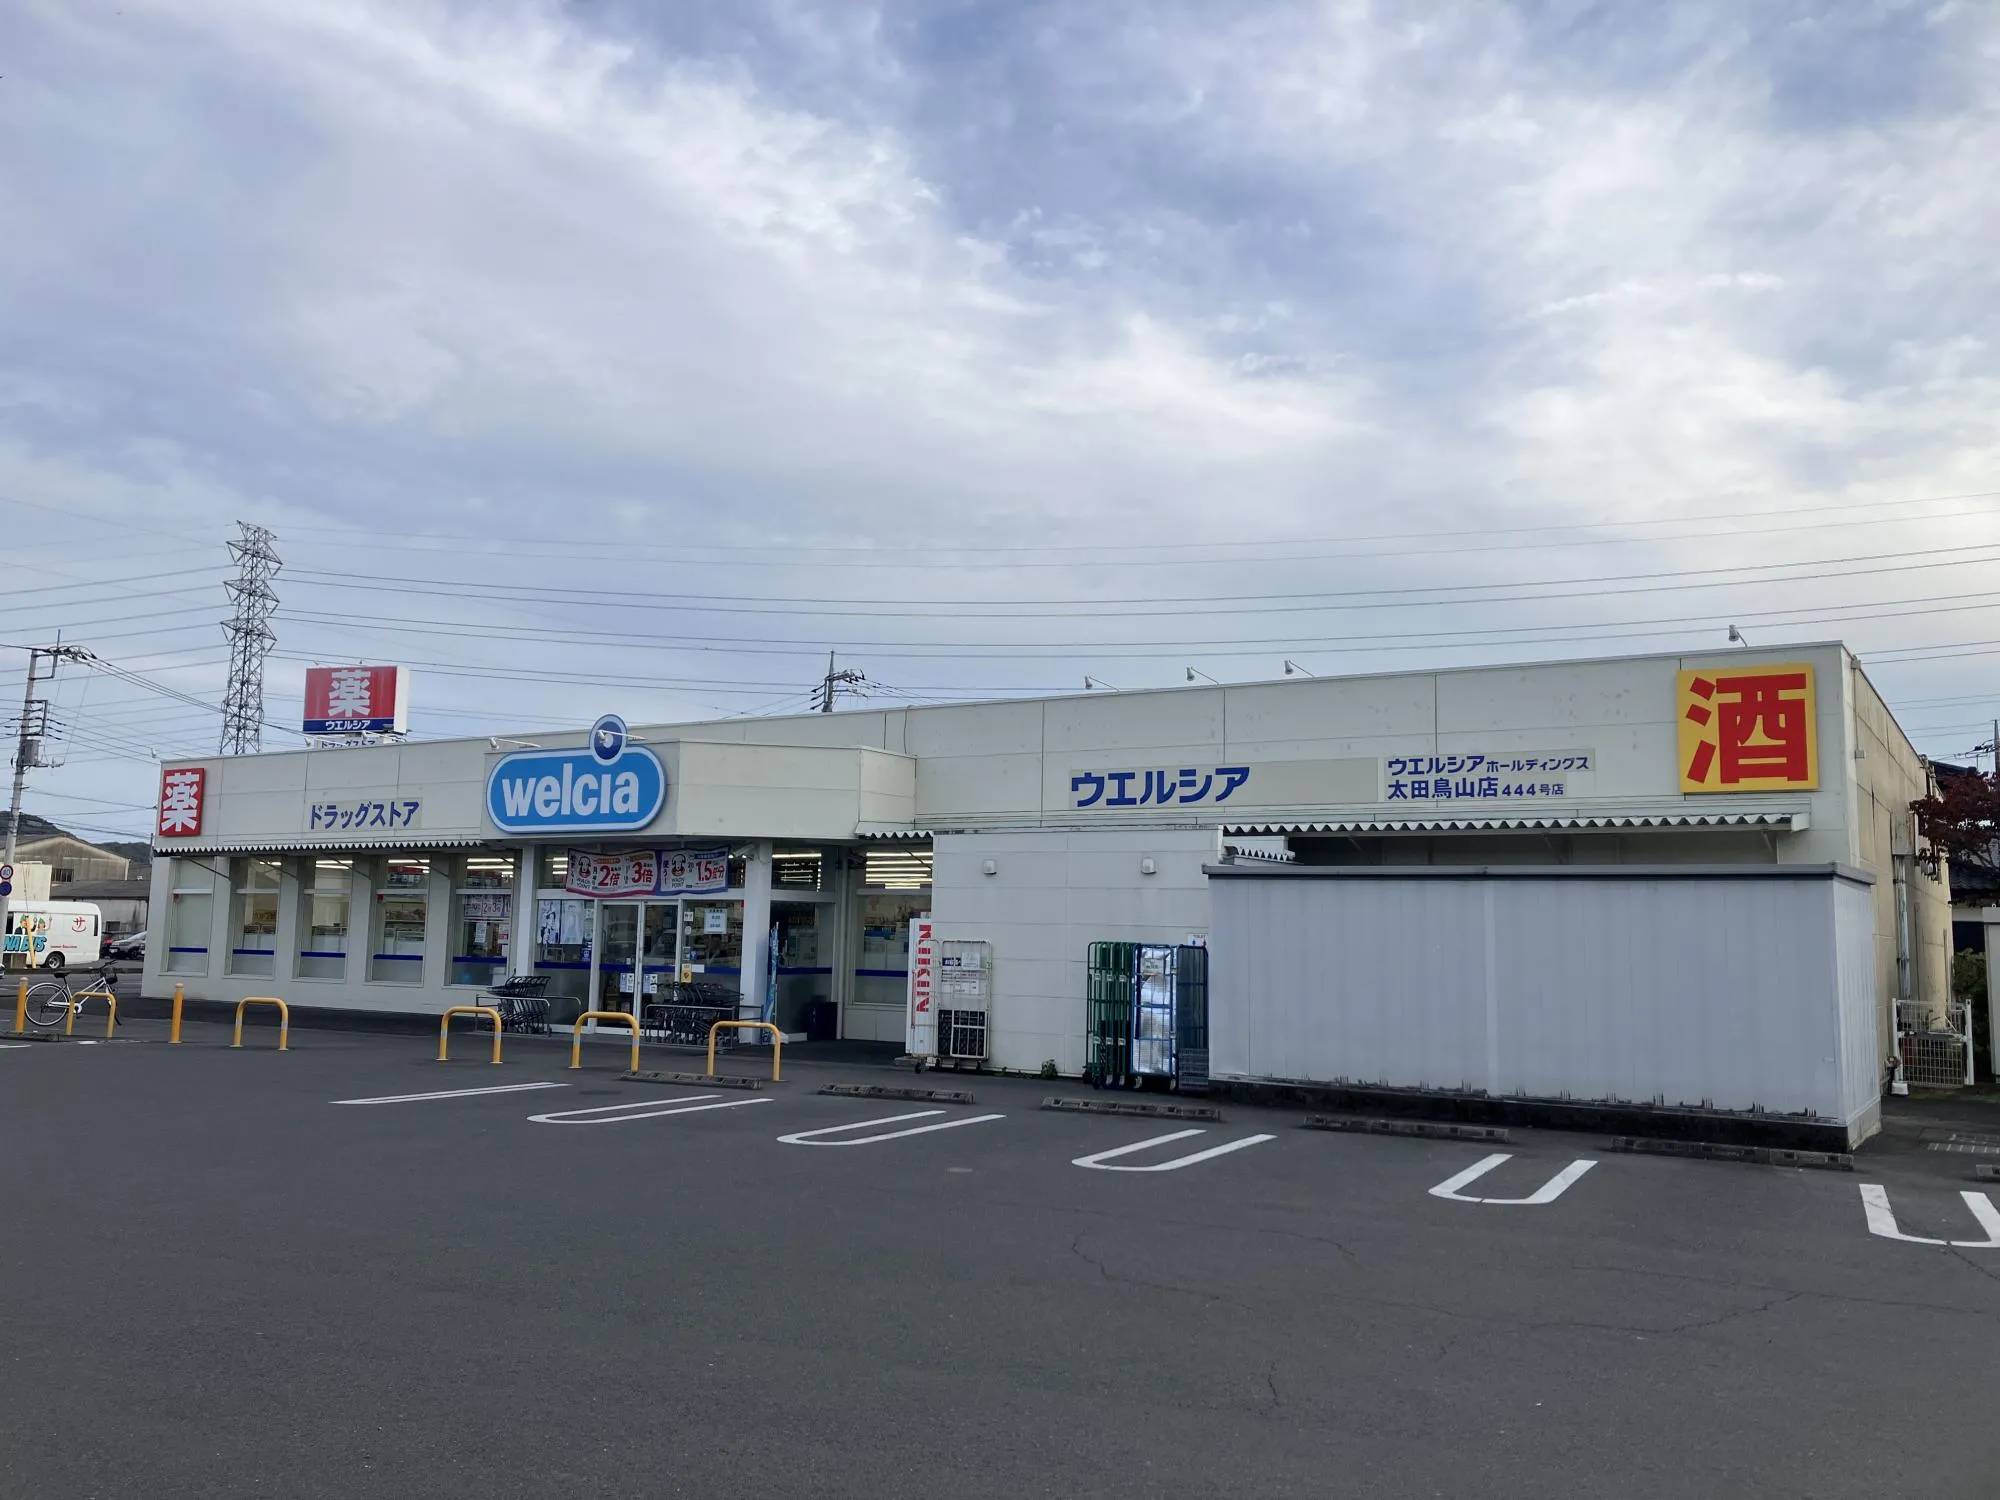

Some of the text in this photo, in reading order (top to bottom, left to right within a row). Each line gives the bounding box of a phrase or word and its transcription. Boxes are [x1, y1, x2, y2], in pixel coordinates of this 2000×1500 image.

[328, 670, 371, 717] 薬
[325, 720, 371, 731] ウエルシア
[1686, 673, 1808, 784] 酒
[160, 771, 200, 832] 薬
[502, 763, 639, 818] welcia
[1071, 766, 1250, 807] ウエルシア
[310, 801, 420, 830] ドラッグストア
[73, 916, 85, 929] サ
[4, 936, 21, 952] NA
